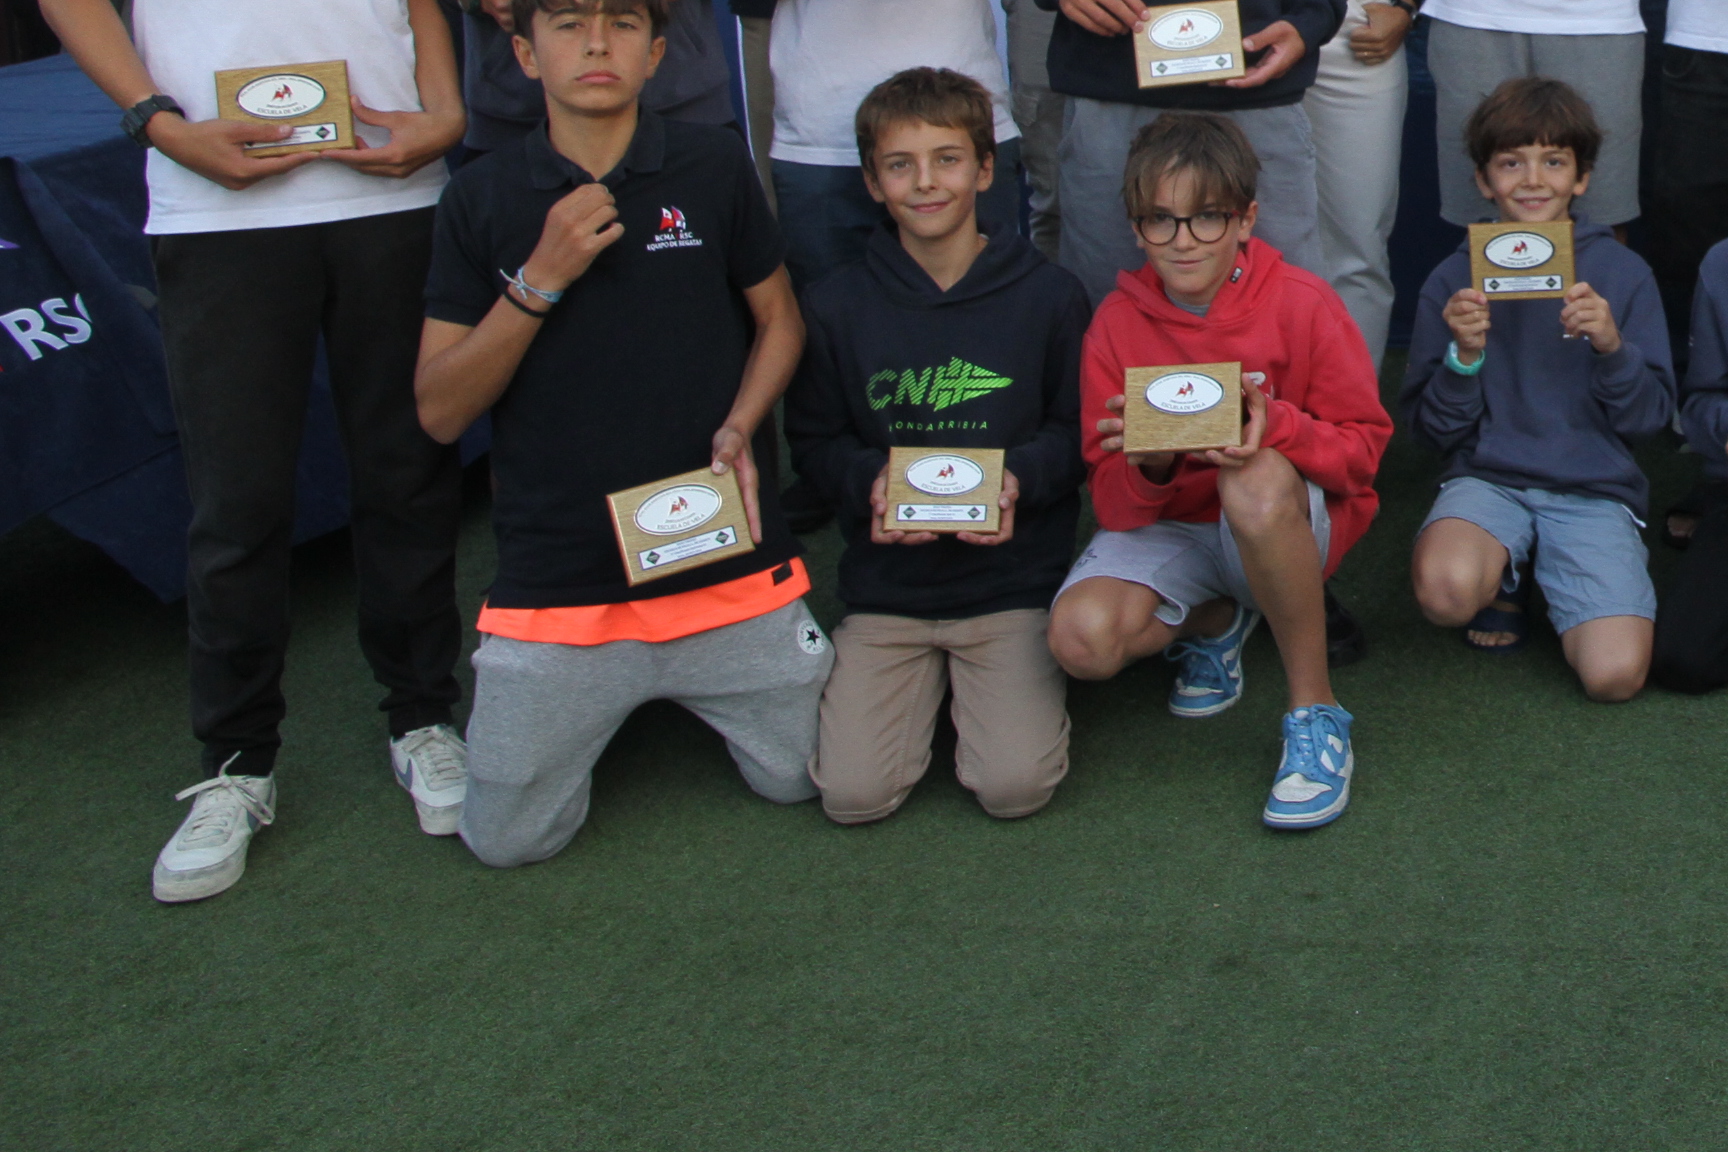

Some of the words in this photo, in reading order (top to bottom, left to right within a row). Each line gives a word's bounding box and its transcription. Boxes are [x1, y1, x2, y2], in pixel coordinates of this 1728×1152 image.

[257, 107, 282, 115] ESCUELA
[0, 293, 93, 361] RS
[690, 513, 706, 524] VELA
